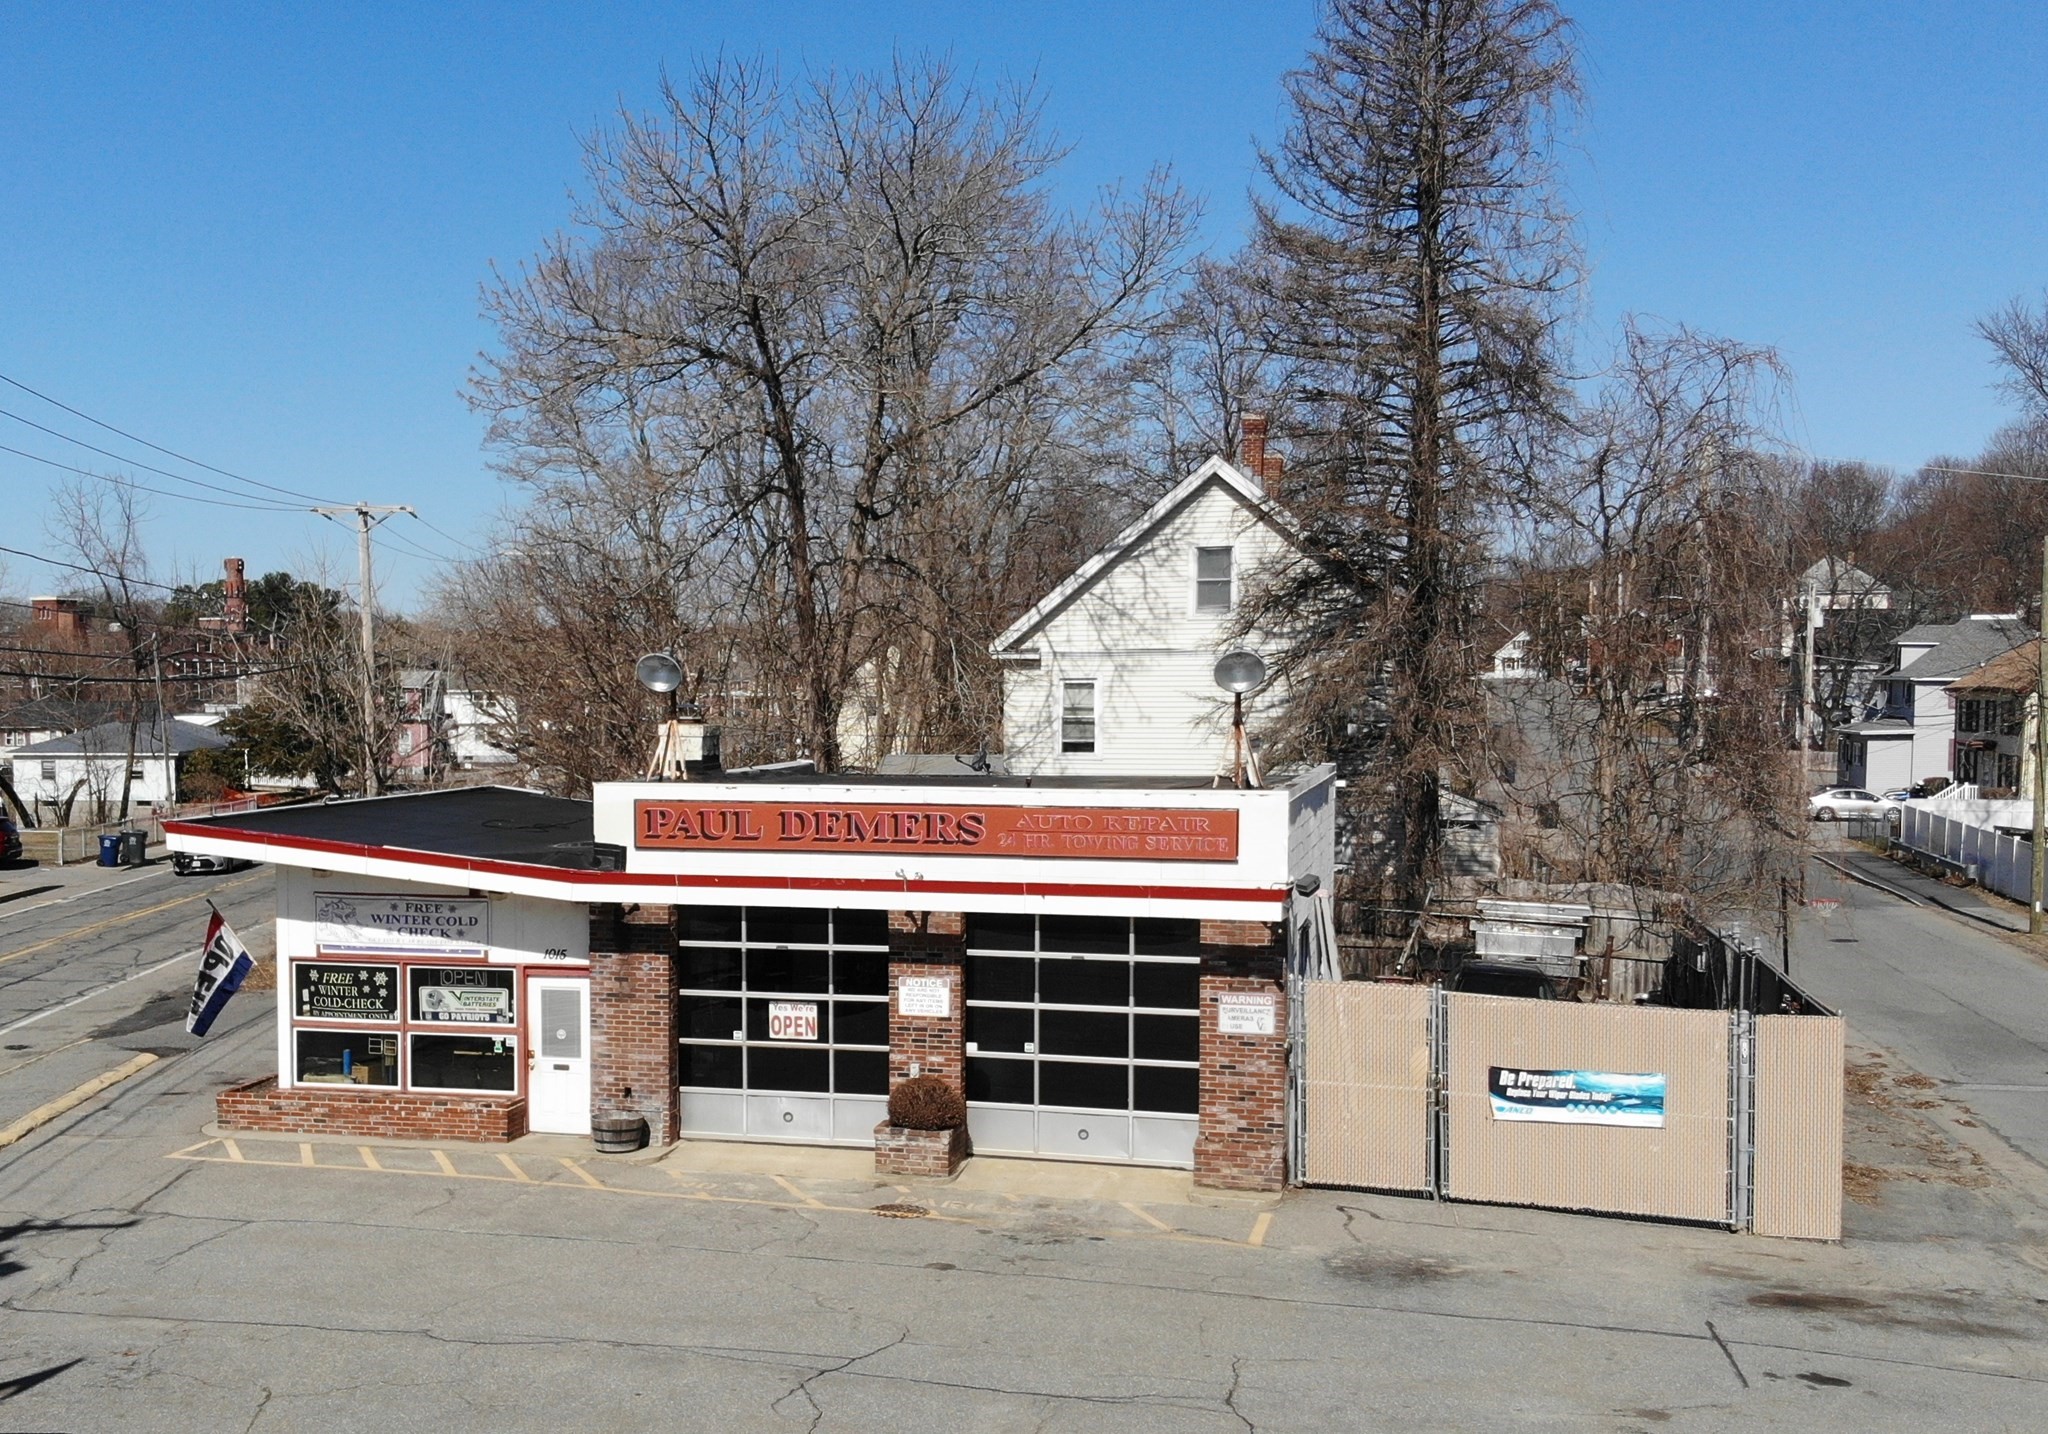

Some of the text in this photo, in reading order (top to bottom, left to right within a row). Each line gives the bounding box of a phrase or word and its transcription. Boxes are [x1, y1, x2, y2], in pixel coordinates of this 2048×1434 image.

[644, 808, 986, 845] PAUL DEMERS
[1016, 814, 1211, 832] AUTO REPAIR
[1061, 834, 1139, 850] TOWING
[1145, 836, 1229, 853] SERVICE
[405, 902, 444, 914] FREE
[370, 914, 478, 927] WINTER COLD
[397, 926, 451, 938] CHECK
[543, 948, 567, 960] 1015
[322, 972, 354, 985] FREE
[442, 969, 485, 986] OPEN
[906, 979, 943, 988] NOTICE
[318, 984, 358, 997] WINTER
[313, 995, 384, 1010] COLD-CHECK
[1221, 995, 1272, 1006] WARNING
[773, 1003, 815, 1012] Yes We're
[321, 1010, 367, 1019] APPOINTMENT
[368, 1012, 390, 1020] ONLY
[438, 1012, 490, 1021] GO PATRIOTS
[770, 1014, 816, 1036] OPEN
[1499, 1070, 1576, 1090] Be Prepared.
